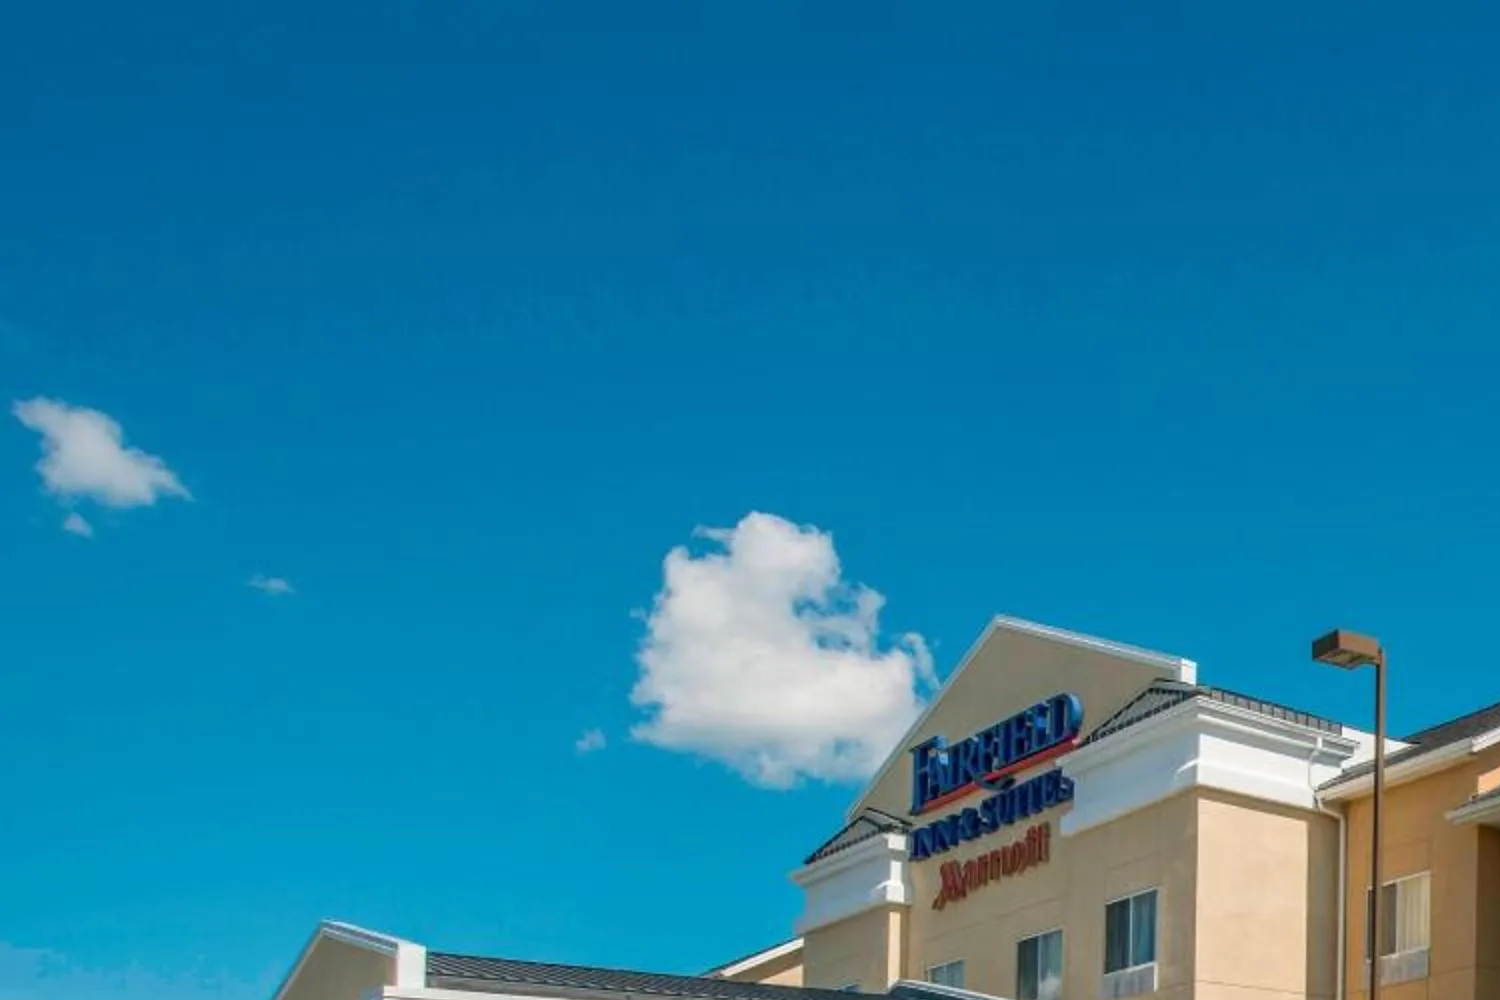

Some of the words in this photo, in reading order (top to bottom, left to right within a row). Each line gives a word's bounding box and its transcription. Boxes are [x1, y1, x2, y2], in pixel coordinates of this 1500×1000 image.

[909, 693, 1083, 815] FAIRFIELD
[909, 814, 959, 861] INN
[980, 768, 1074, 834] SUITES
[932, 822, 1050, 910] Marriott
